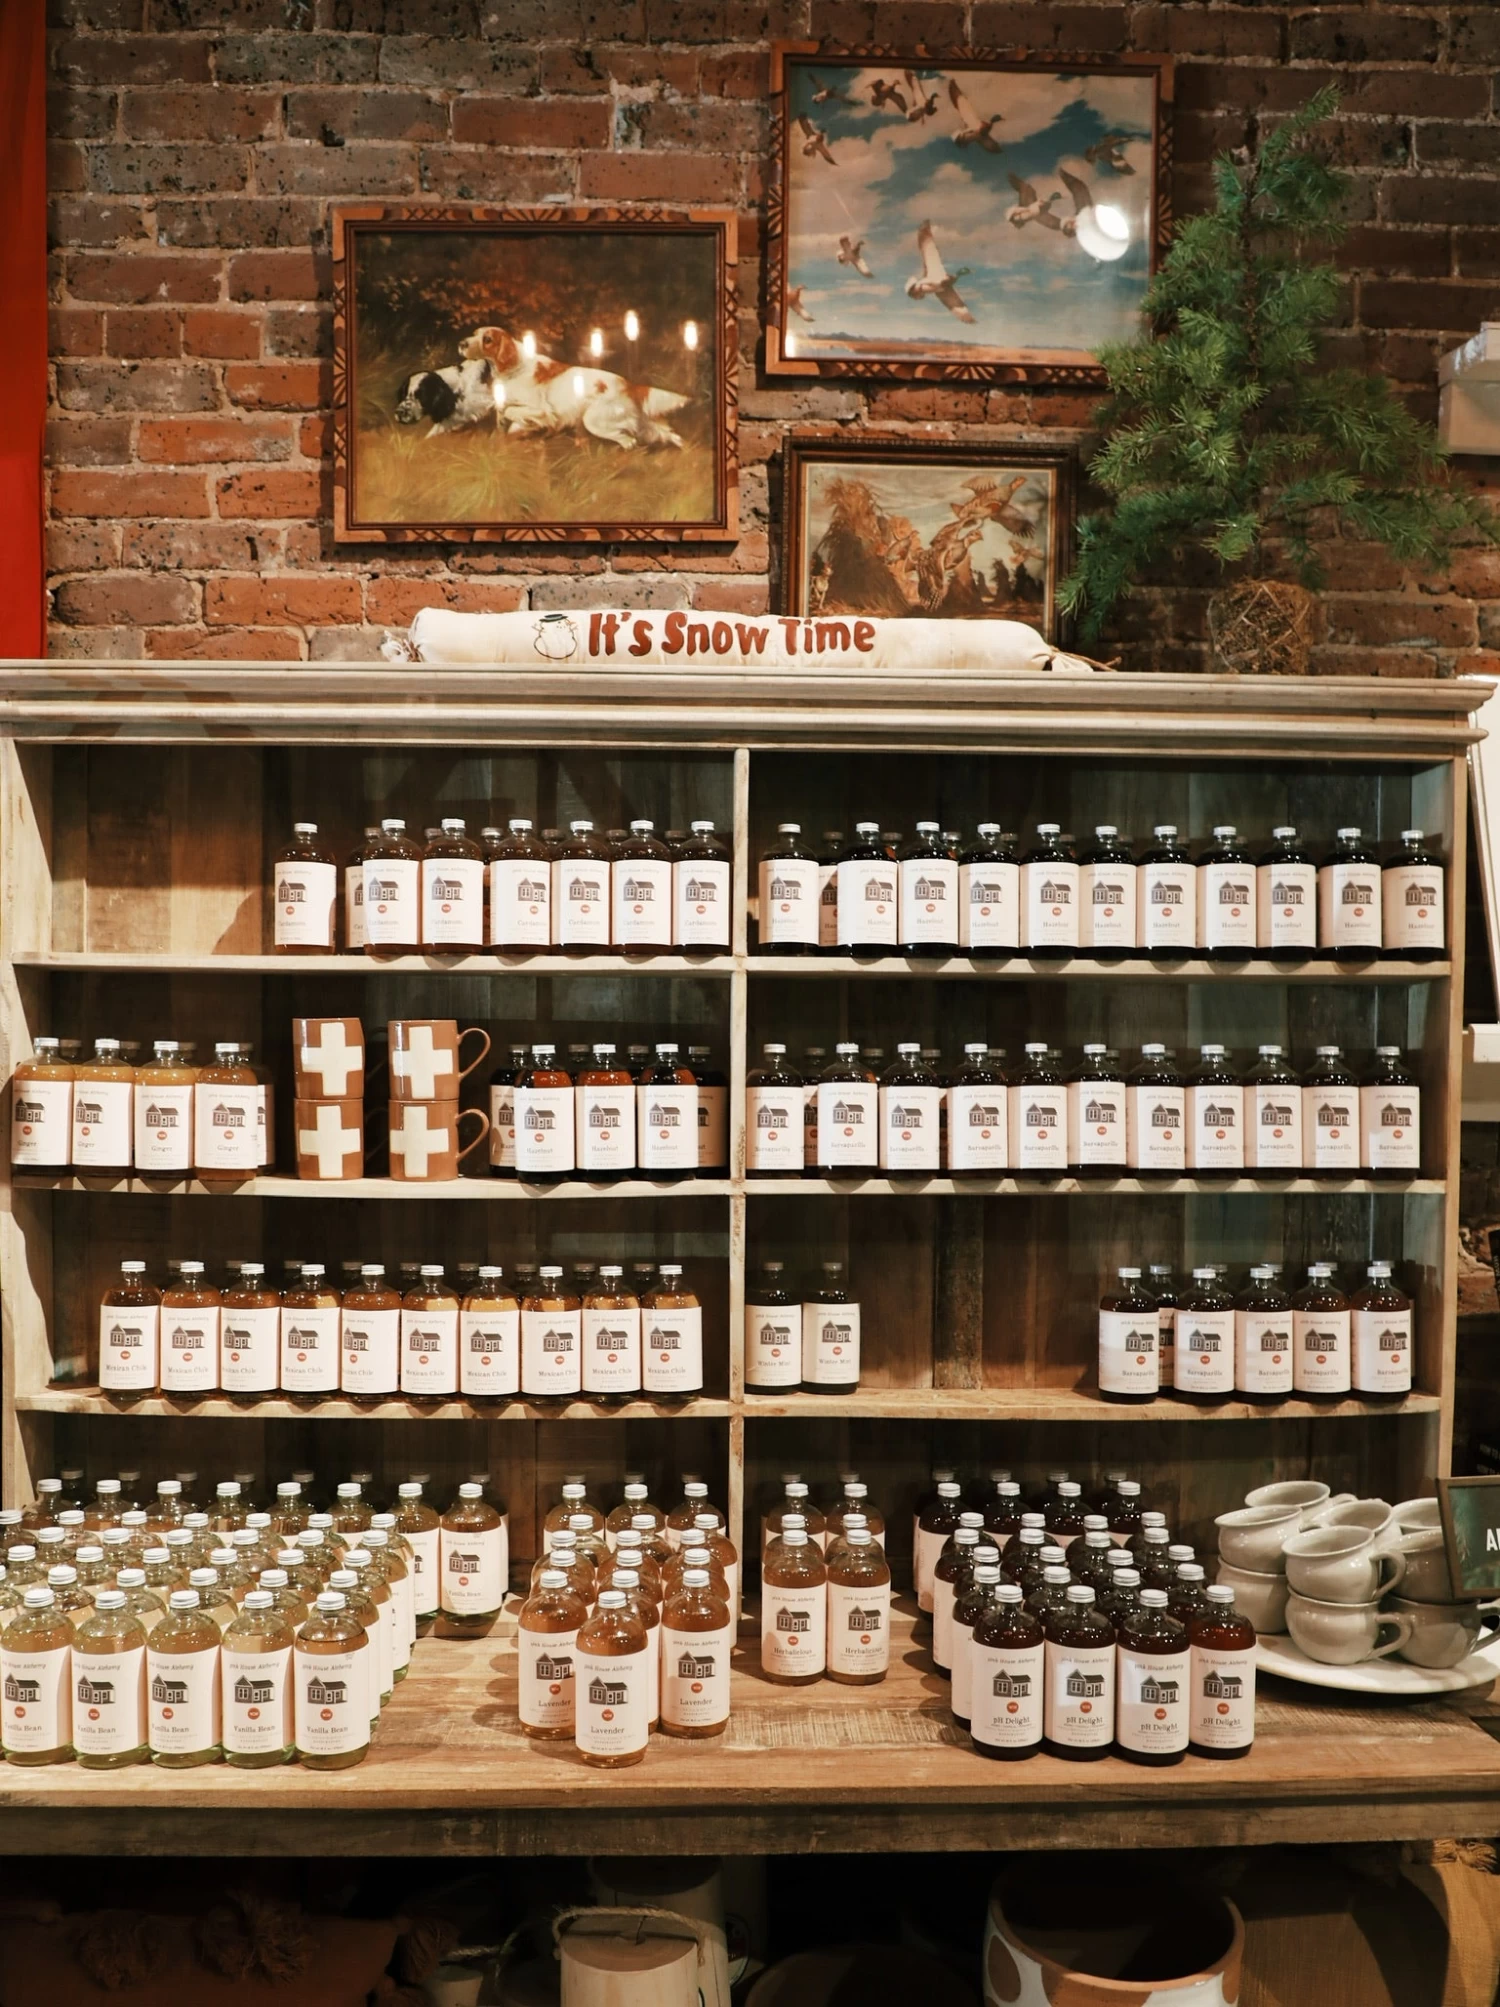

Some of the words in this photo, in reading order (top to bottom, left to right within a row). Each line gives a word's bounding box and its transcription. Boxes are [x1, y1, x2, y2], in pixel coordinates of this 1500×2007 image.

[589, 612, 653, 656] It's
[661, 612, 769, 655] Snow
[778, 619, 876, 655] Time
[1486, 1528, 1500, 1552] A
[538, 1699, 572, 1707] Lavender
[680, 1697, 712, 1706] Lavender
[993, 1716, 1003, 1725] pH
[1005, 1716, 1030, 1726] Delight
[1066, 1716, 1078, 1725] pH
[1079, 1716, 1103, 1726] Delight
[1203, 1718, 1215, 1726] pH
[1216, 1718, 1241, 1727] Delight
[24, 1724, 42, 1732] Bean
[99, 1725, 116, 1733] Bean
[172, 1725, 190, 1733] Bean
[258, 1725, 276, 1733] Bean
[331, 1725, 348, 1734] Bean
[590, 1725, 625, 1735] Lavender
[1141, 1723, 1152, 1732] pH
[1154, 1723, 1177, 1733] Delight
